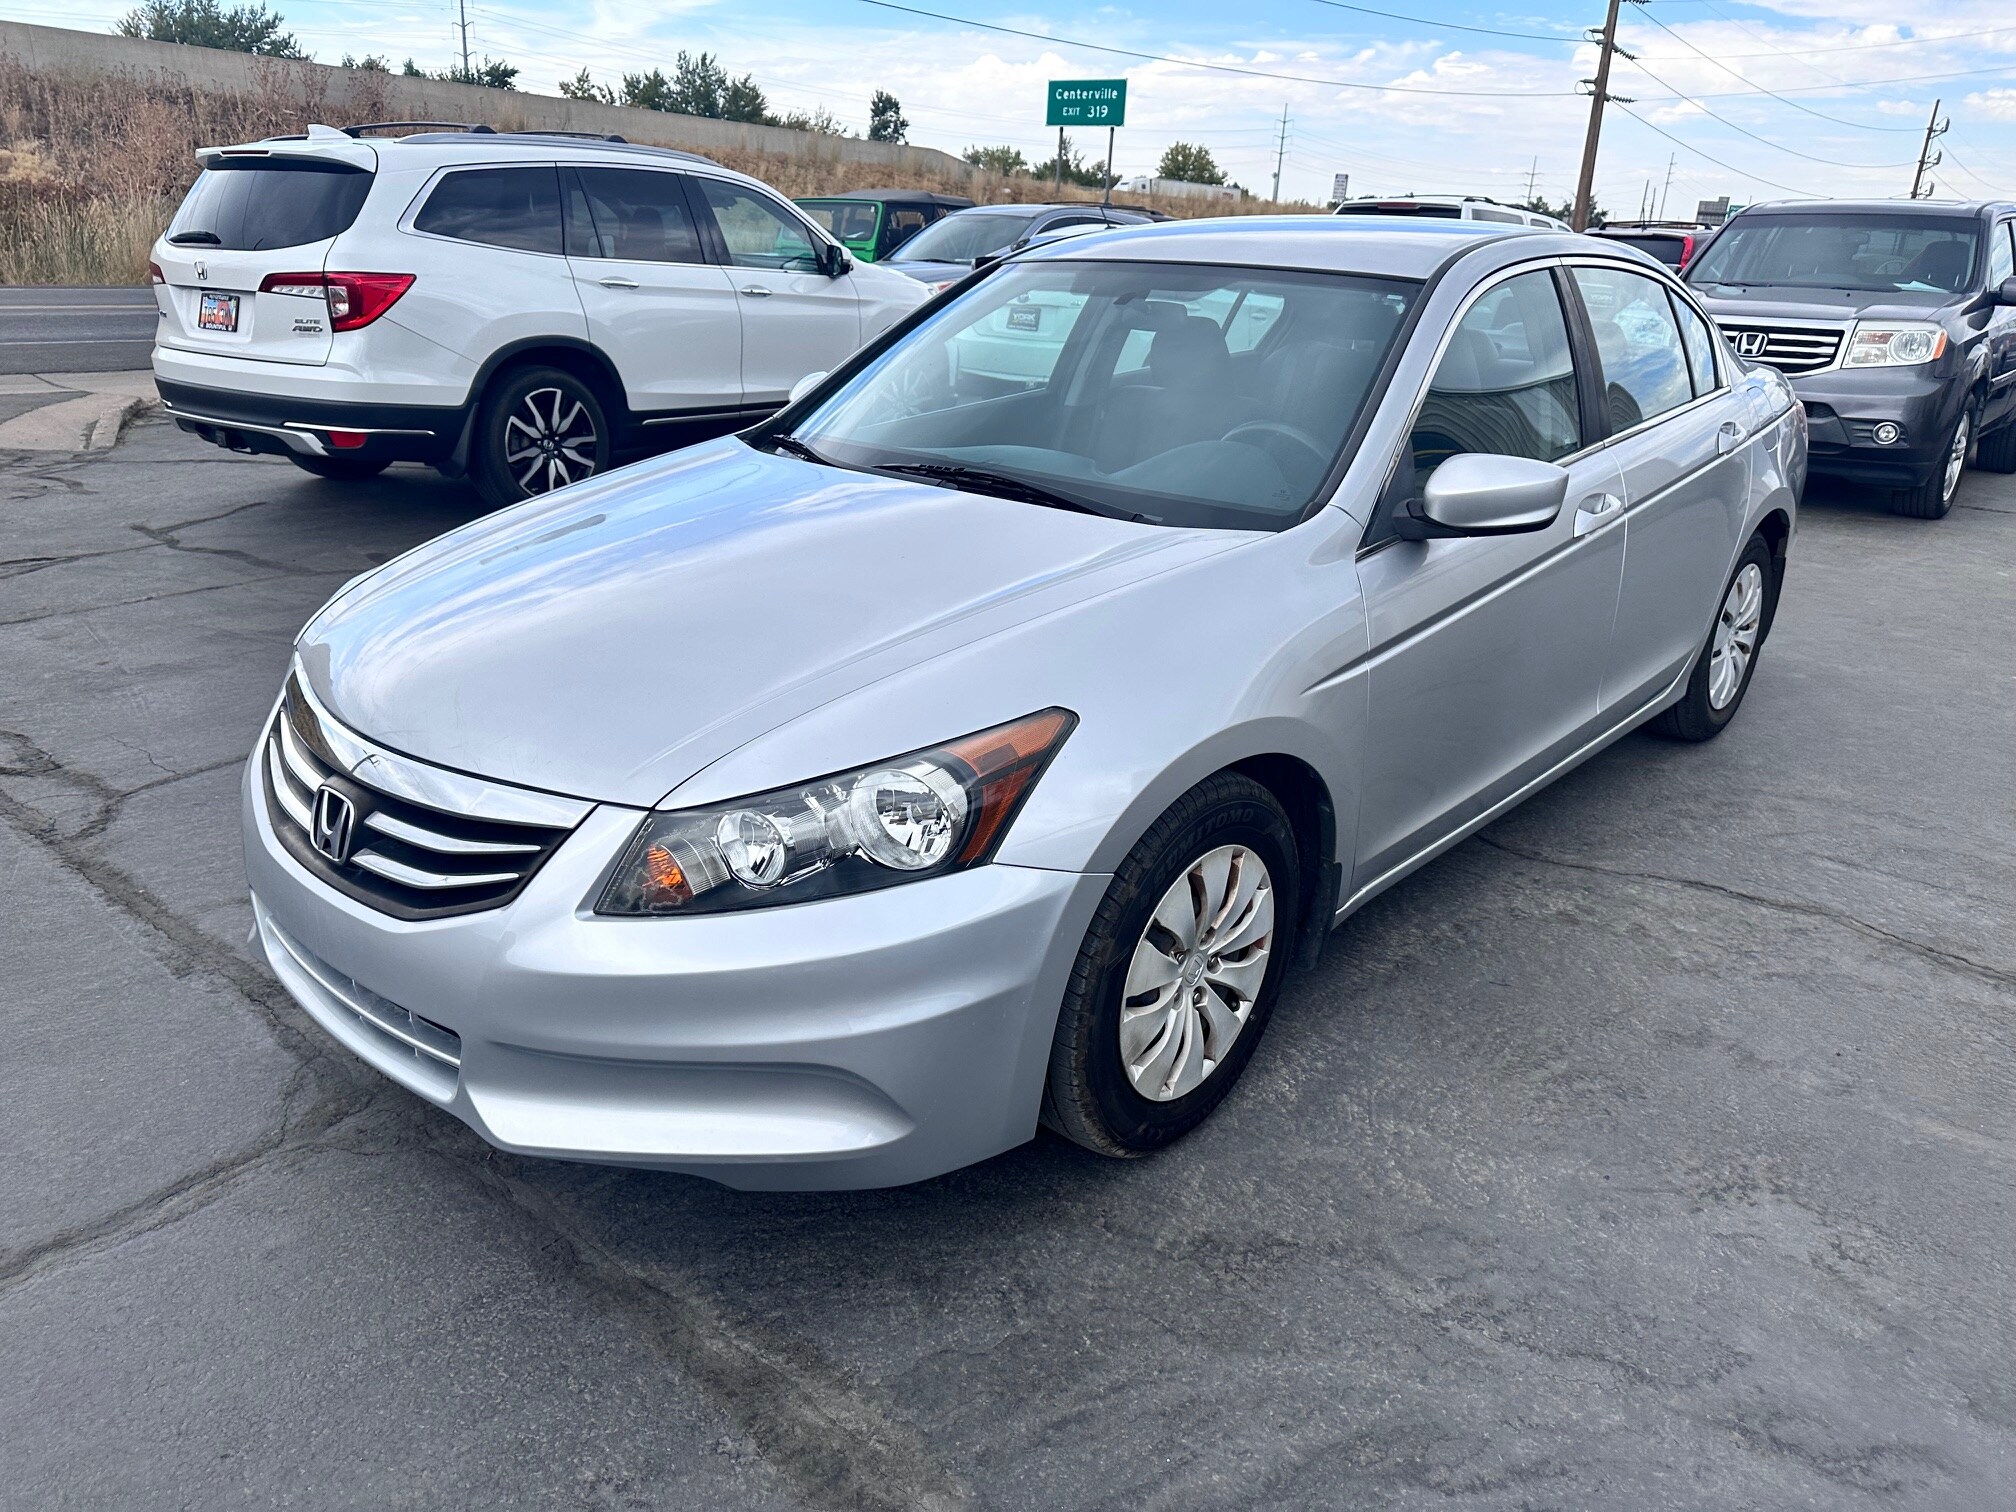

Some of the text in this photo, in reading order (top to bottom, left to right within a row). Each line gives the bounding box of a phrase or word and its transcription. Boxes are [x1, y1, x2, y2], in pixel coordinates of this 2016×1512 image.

[1055, 87, 1118, 100] Centerville
[1062, 105, 1109, 118] EXIT 319
[292, 325, 323, 333] AWD
[1153, 807, 1255, 894] SUMITOMO
